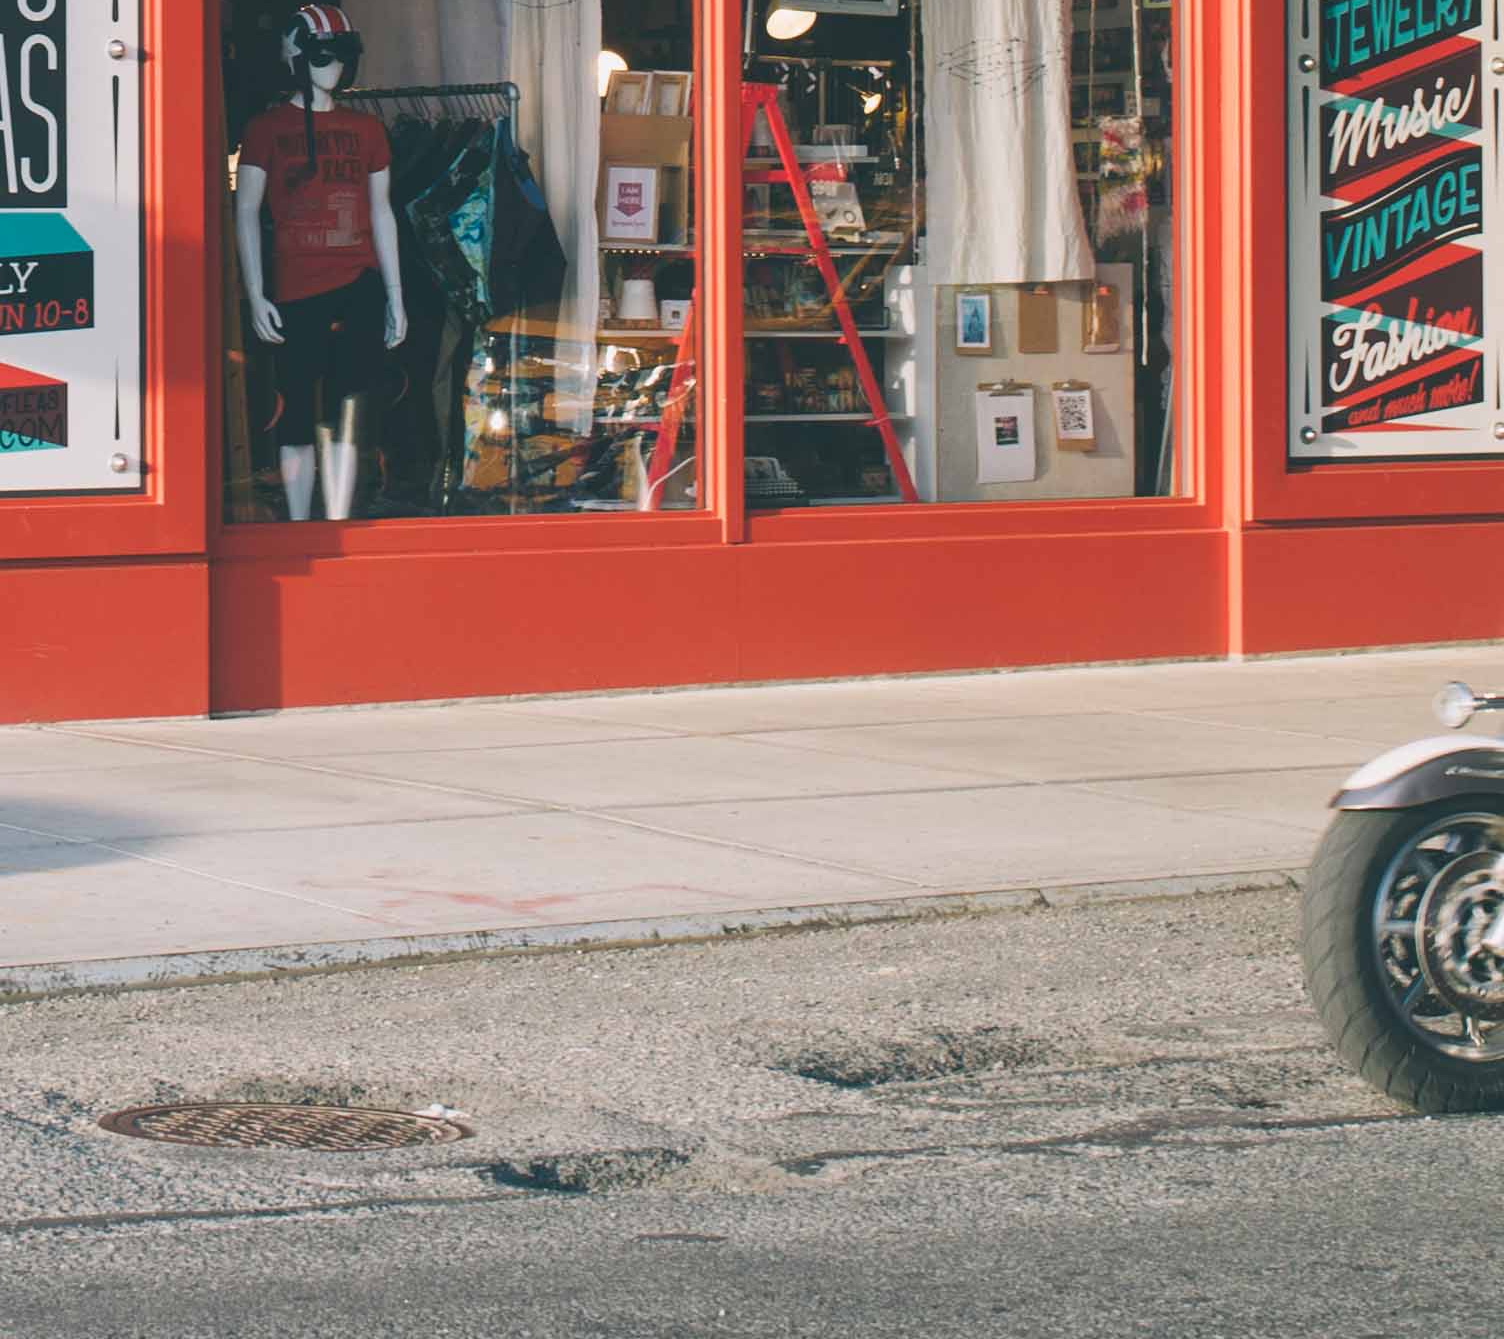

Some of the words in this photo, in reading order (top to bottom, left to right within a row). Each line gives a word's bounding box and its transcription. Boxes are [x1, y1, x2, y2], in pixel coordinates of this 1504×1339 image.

[1328, 74, 1476, 175] Music
[1326, 163, 1480, 280] VINTAGE
[34, 298, 90, 328] 10-8
[1329, 297, 1479, 393] Fashion
[1348, 398, 1380, 426] and
[1383, 382, 1426, 421] much
[1430, 359, 1481, 410] more!
